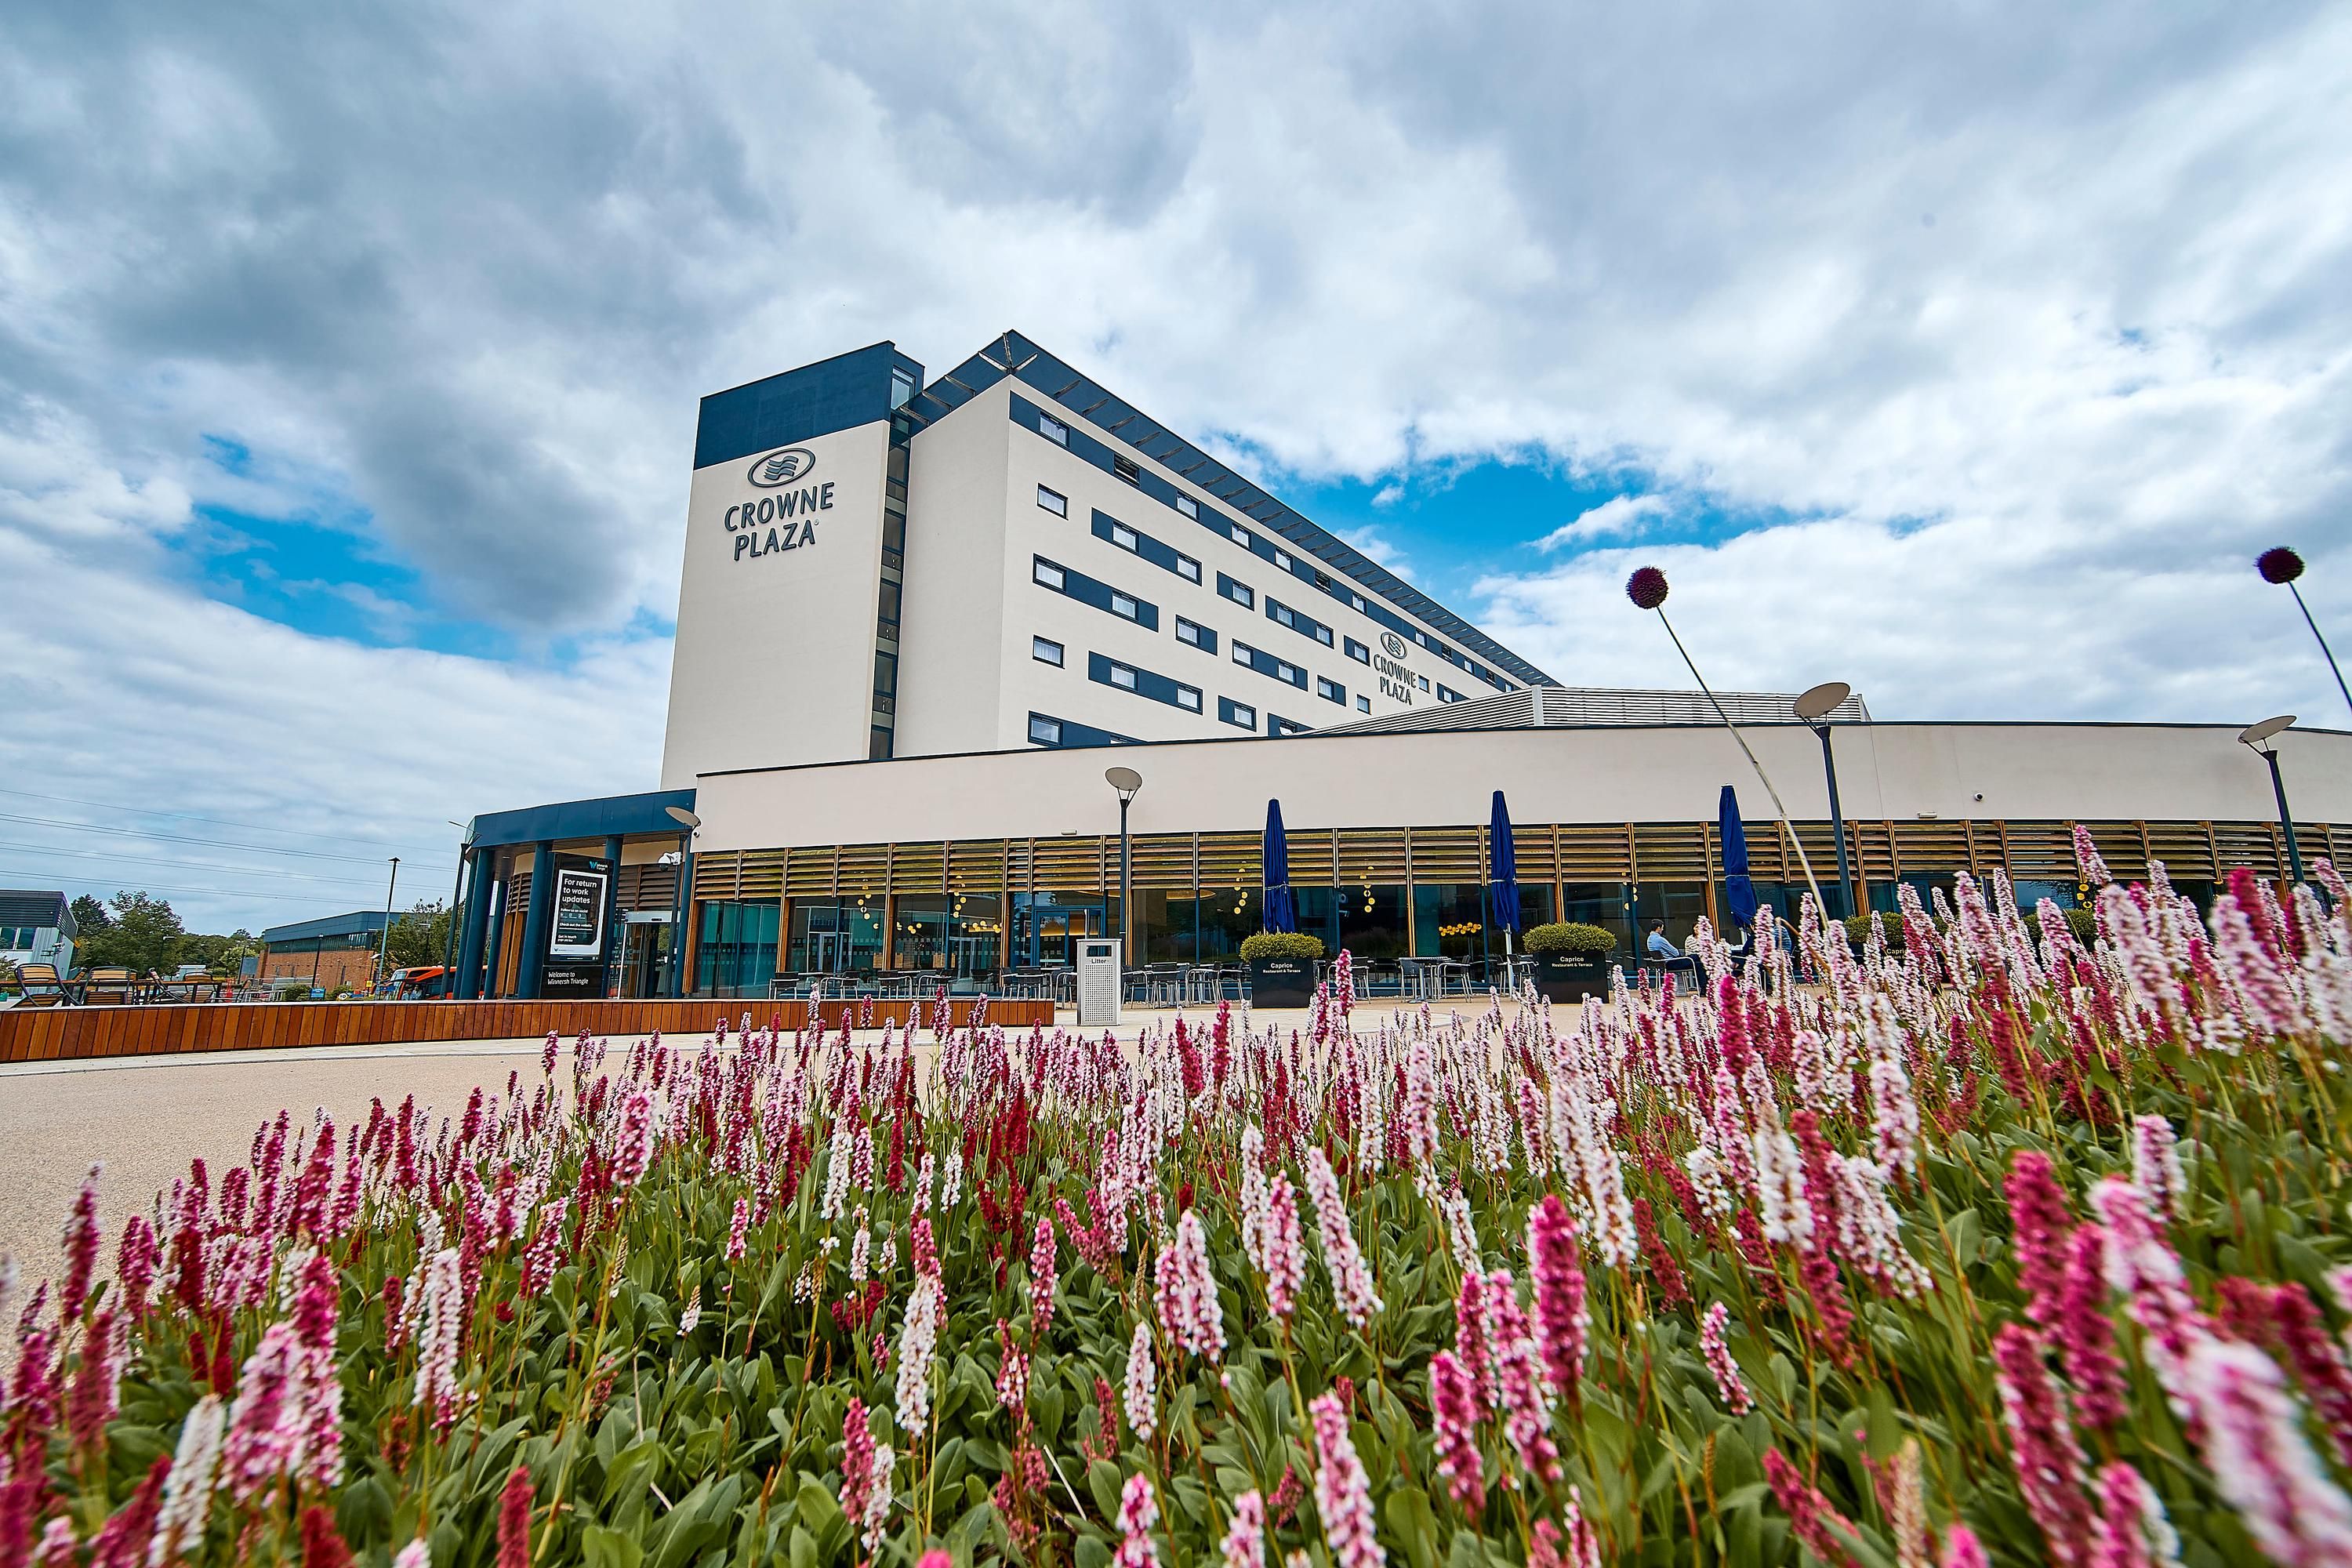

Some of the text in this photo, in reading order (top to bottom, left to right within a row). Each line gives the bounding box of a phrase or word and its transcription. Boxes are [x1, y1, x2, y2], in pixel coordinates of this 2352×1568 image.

[724, 481, 835, 532] CROWNE
[734, 519, 816, 561] PLAZA
[1374, 654, 1417, 688] CROWNE
[1380, 676, 1412, 706] PLAZA
